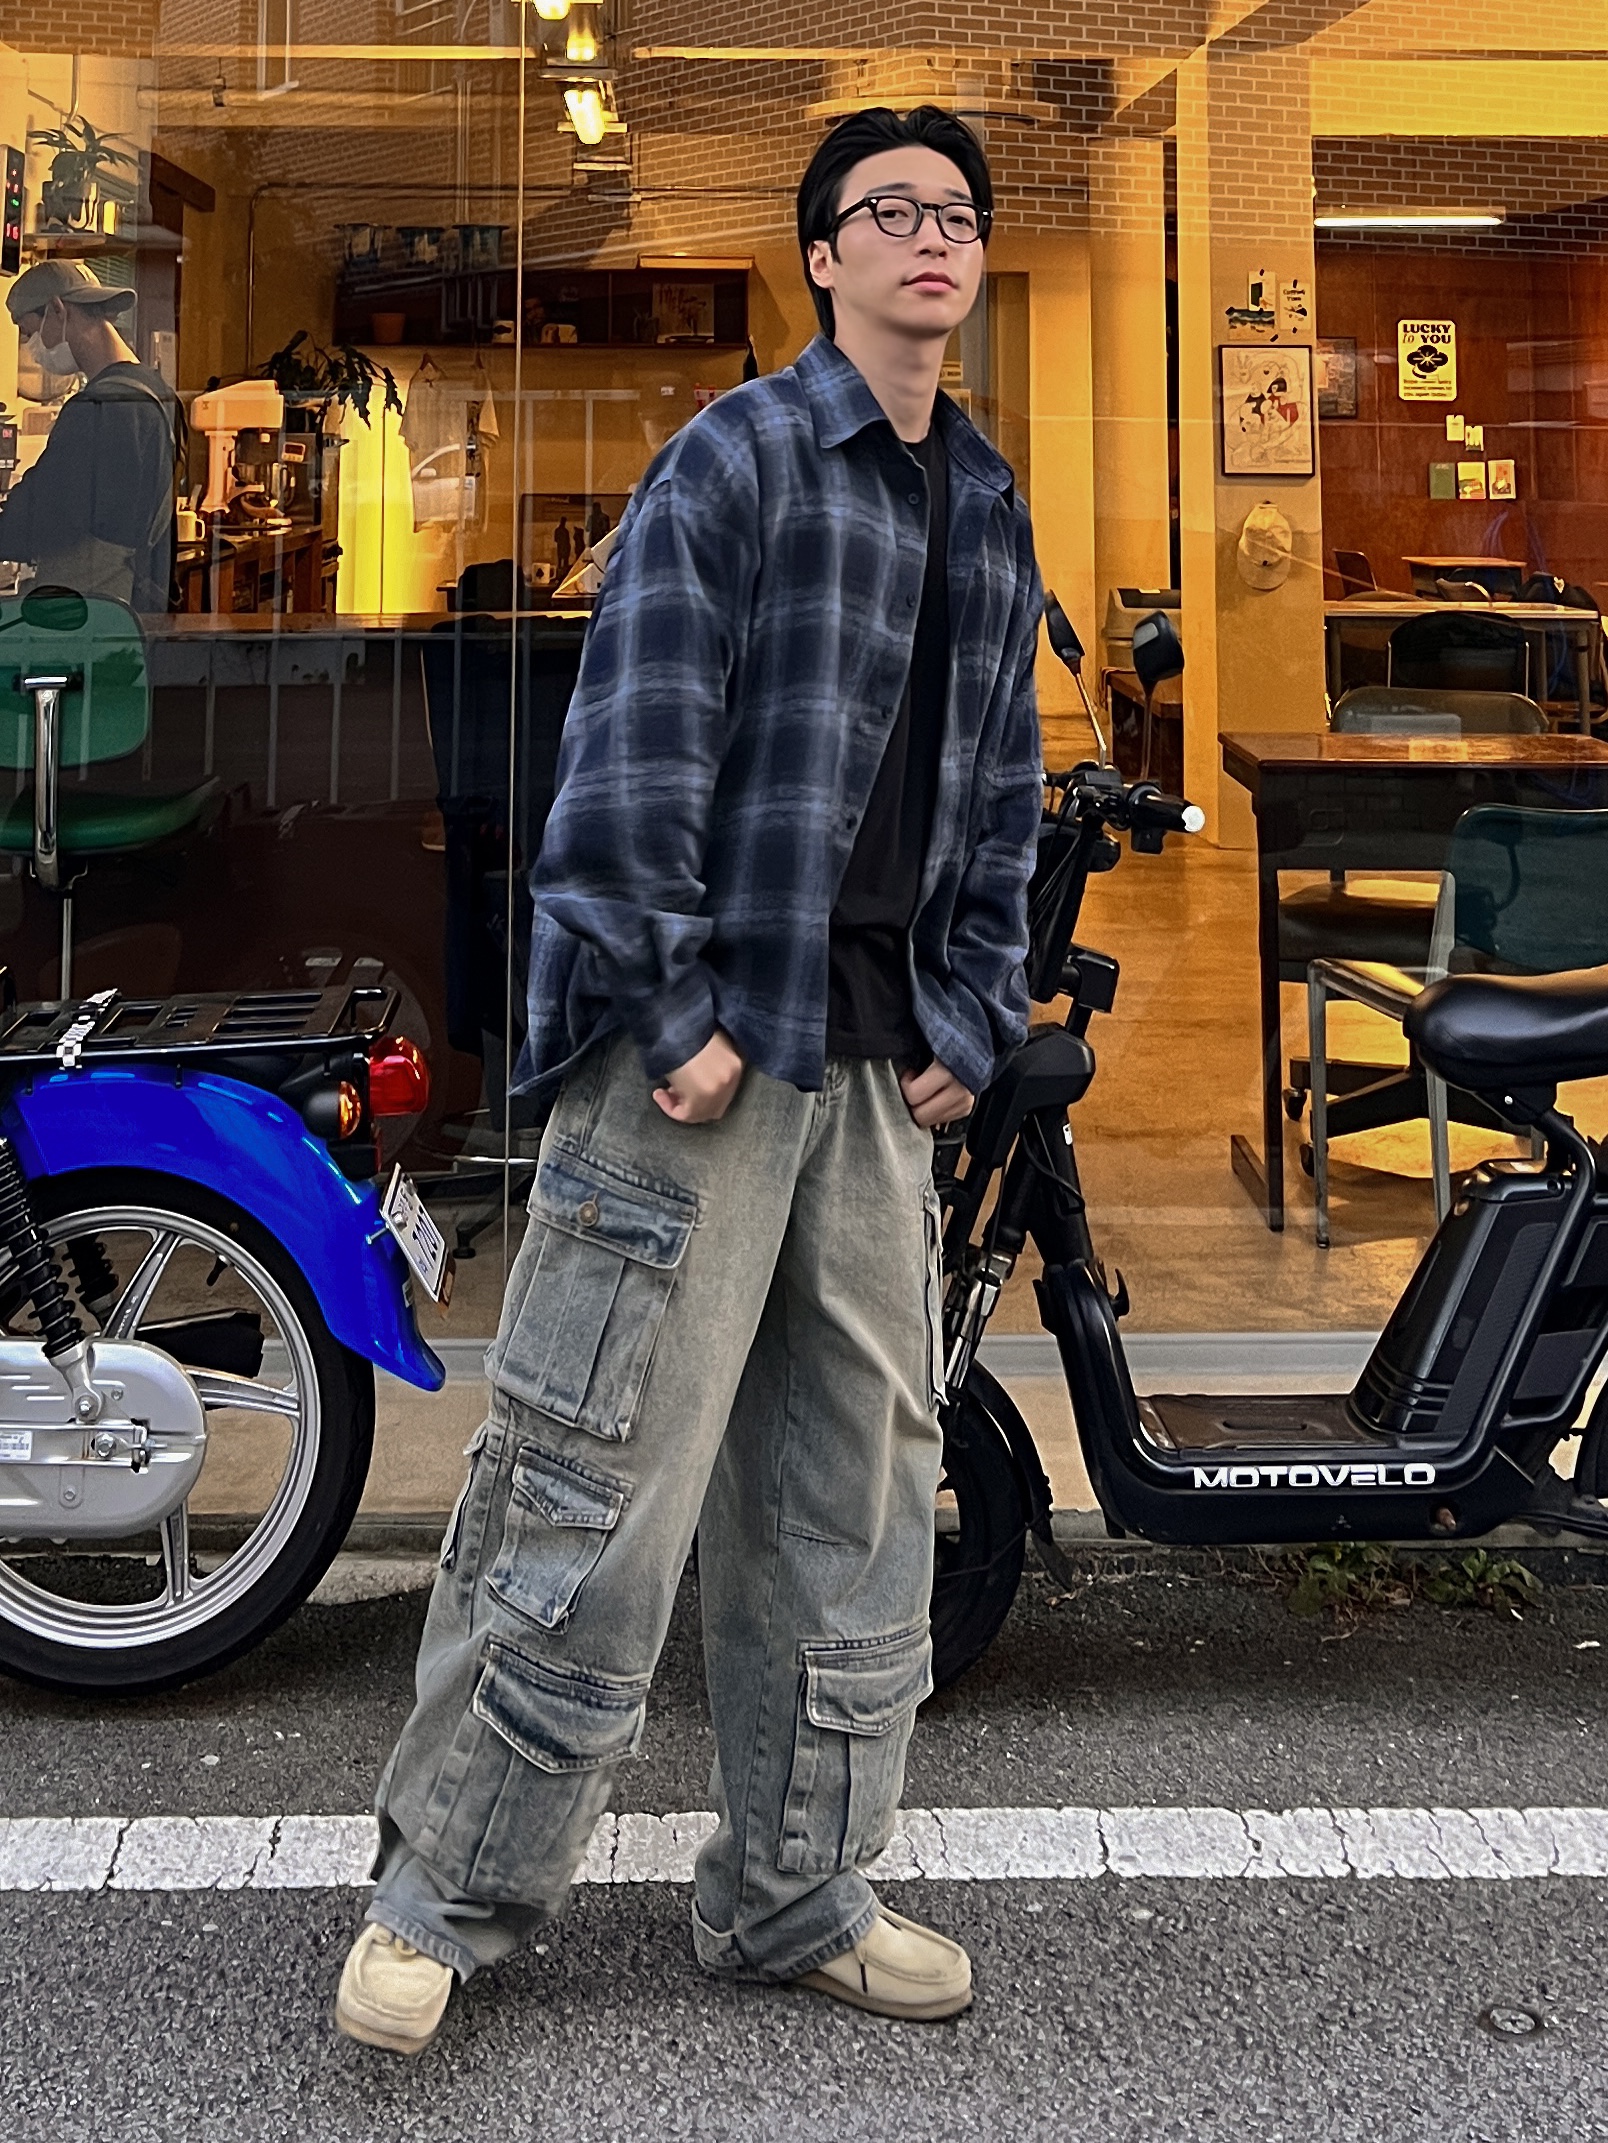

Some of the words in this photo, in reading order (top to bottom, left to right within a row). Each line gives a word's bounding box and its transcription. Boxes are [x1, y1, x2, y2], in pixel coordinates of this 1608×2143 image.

[1403, 324, 1451, 333] LUCKY
[1421, 334, 1451, 344] YOU
[1193, 1462, 1436, 1488] MOTOVELO
